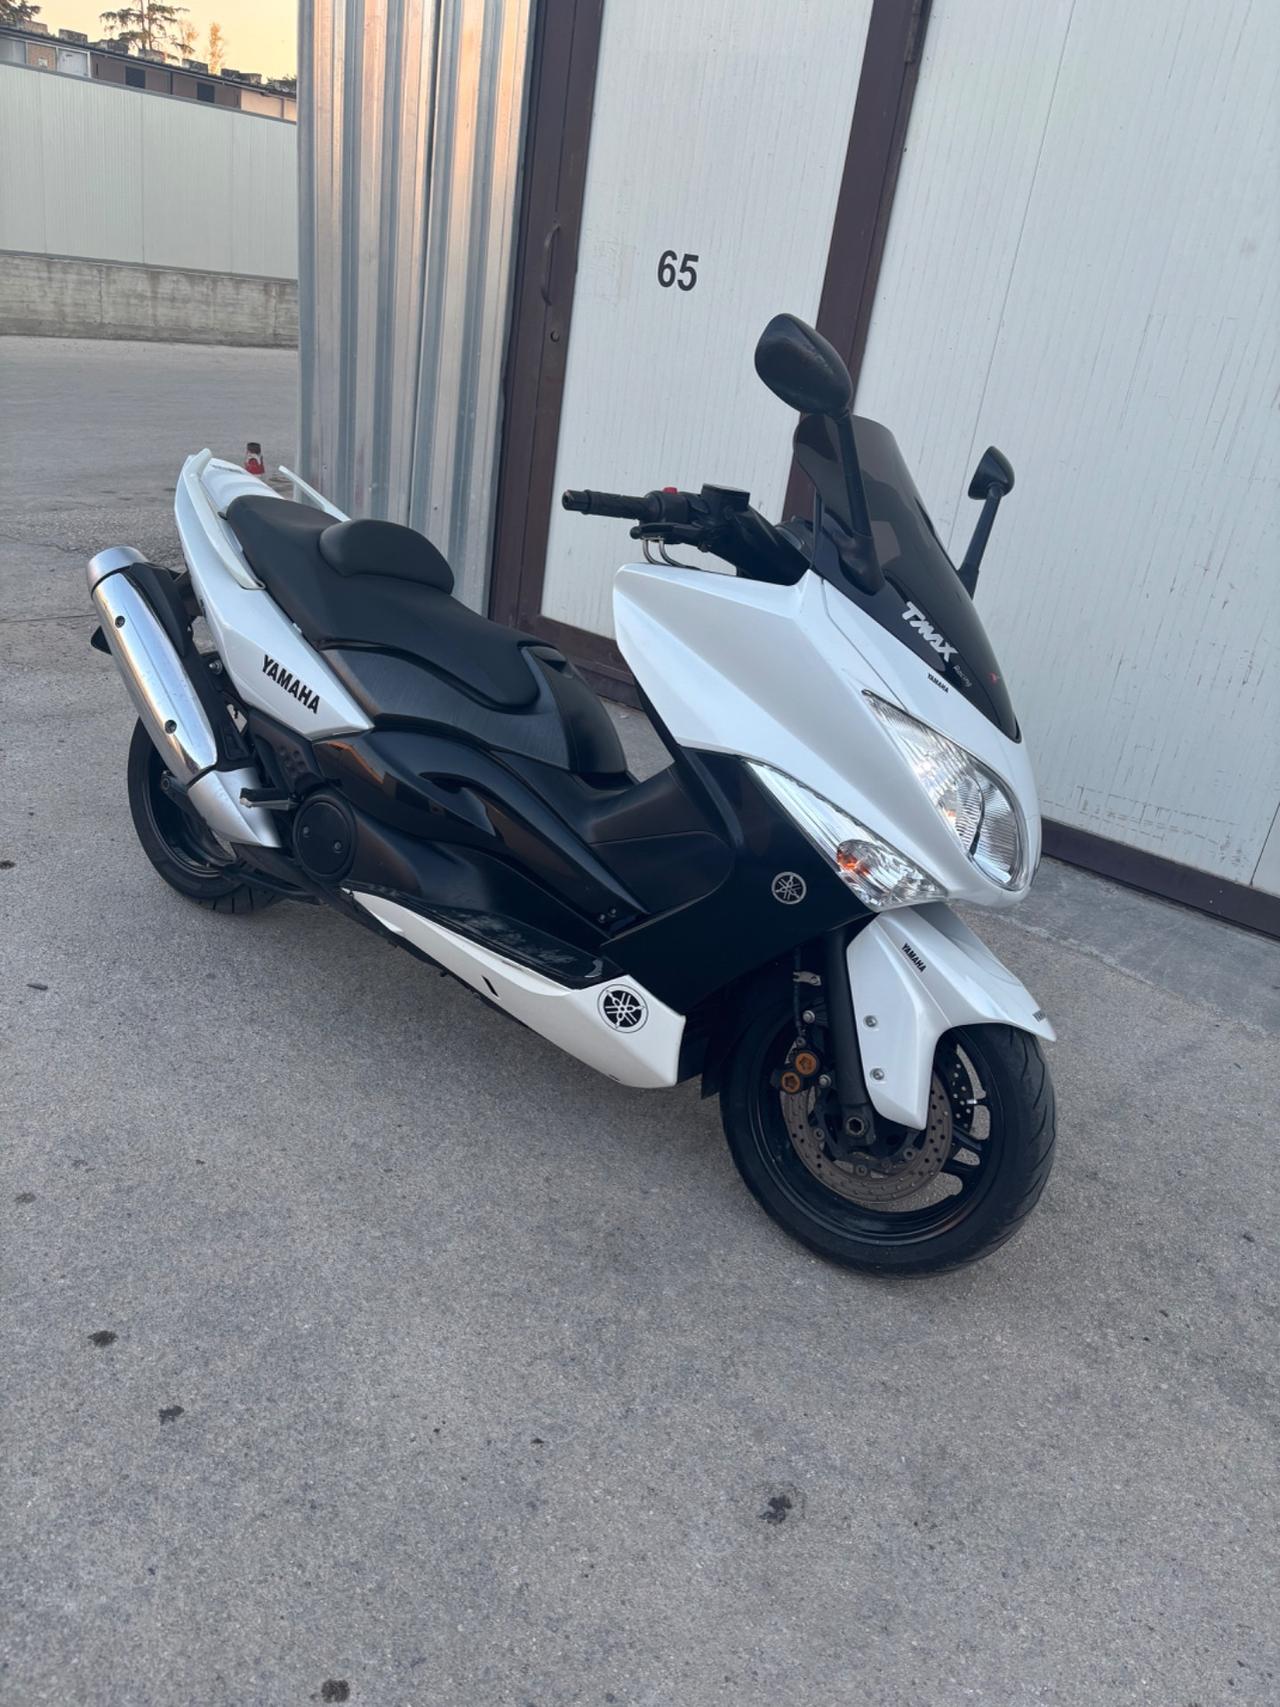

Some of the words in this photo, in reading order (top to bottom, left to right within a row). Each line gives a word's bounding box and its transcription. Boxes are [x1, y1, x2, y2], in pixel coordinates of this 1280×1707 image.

[657, 249, 699, 291] 65
[902, 601, 959, 662] TMAX
[262, 654, 320, 714] YAMAHA
[927, 673, 949, 693] YAMAHA
[902, 942, 927, 972] YAMAHA
